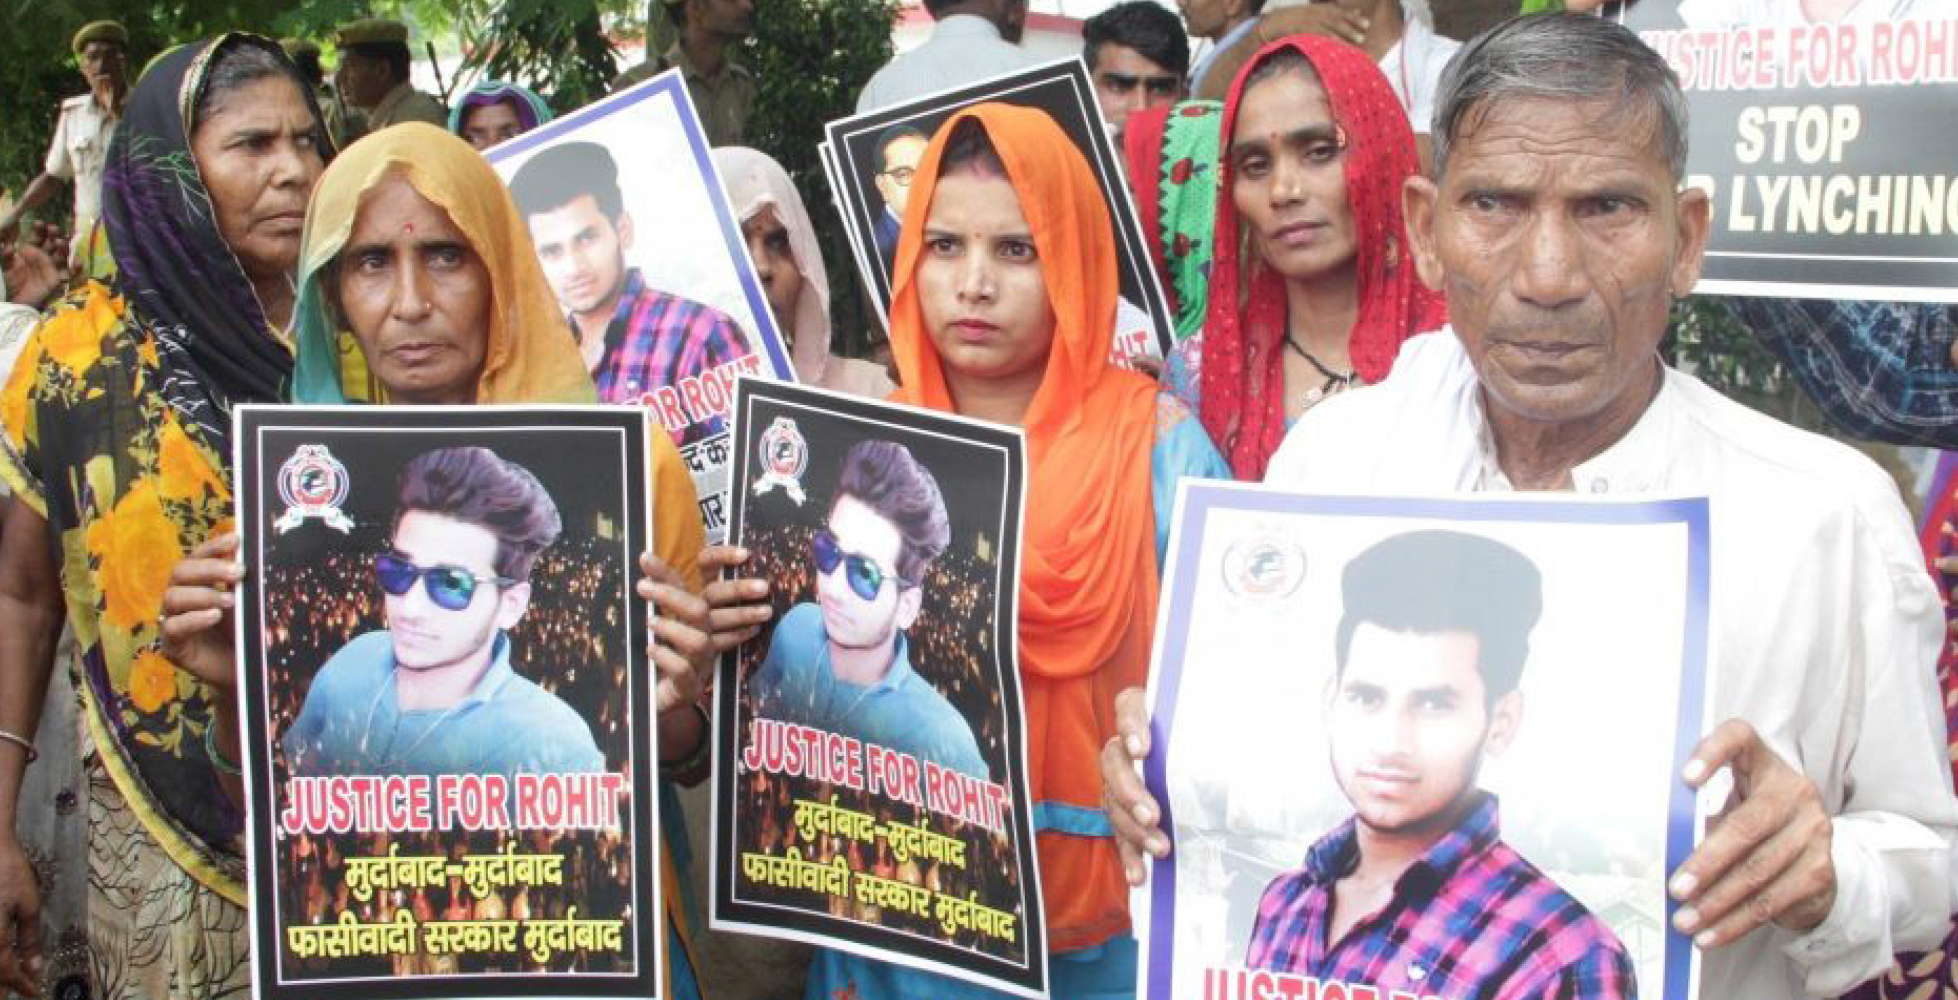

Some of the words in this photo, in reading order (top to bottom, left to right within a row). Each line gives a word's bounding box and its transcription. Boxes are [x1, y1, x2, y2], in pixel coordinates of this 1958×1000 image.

[1648, 26, 1778, 90] STICE
[1785, 23, 1858, 88] FOR
[1868, 18, 1958, 85] ROHI
[1735, 104, 1861, 164] STOP
[282, 776, 432, 833] JUSTICE
[437, 773, 509, 831] FOR
[515, 773, 623, 831] ROHIT
[744, 717, 864, 790] JUSTICE
[866, 743, 923, 806] FOR
[925, 760, 1009, 834] ROHIT
[345, 842, 564, 901] मुर्दाबाद-मुर्दाबाद
[742, 845, 849, 898] फासीवादी
[854, 872, 932, 918] सरकार
[934, 890, 1015, 942] मुर्दाबाद
[287, 909, 416, 958] फासीवादी
[424, 920, 517, 953] सरकार
[523, 906, 623, 963] मुर्दाबाद
